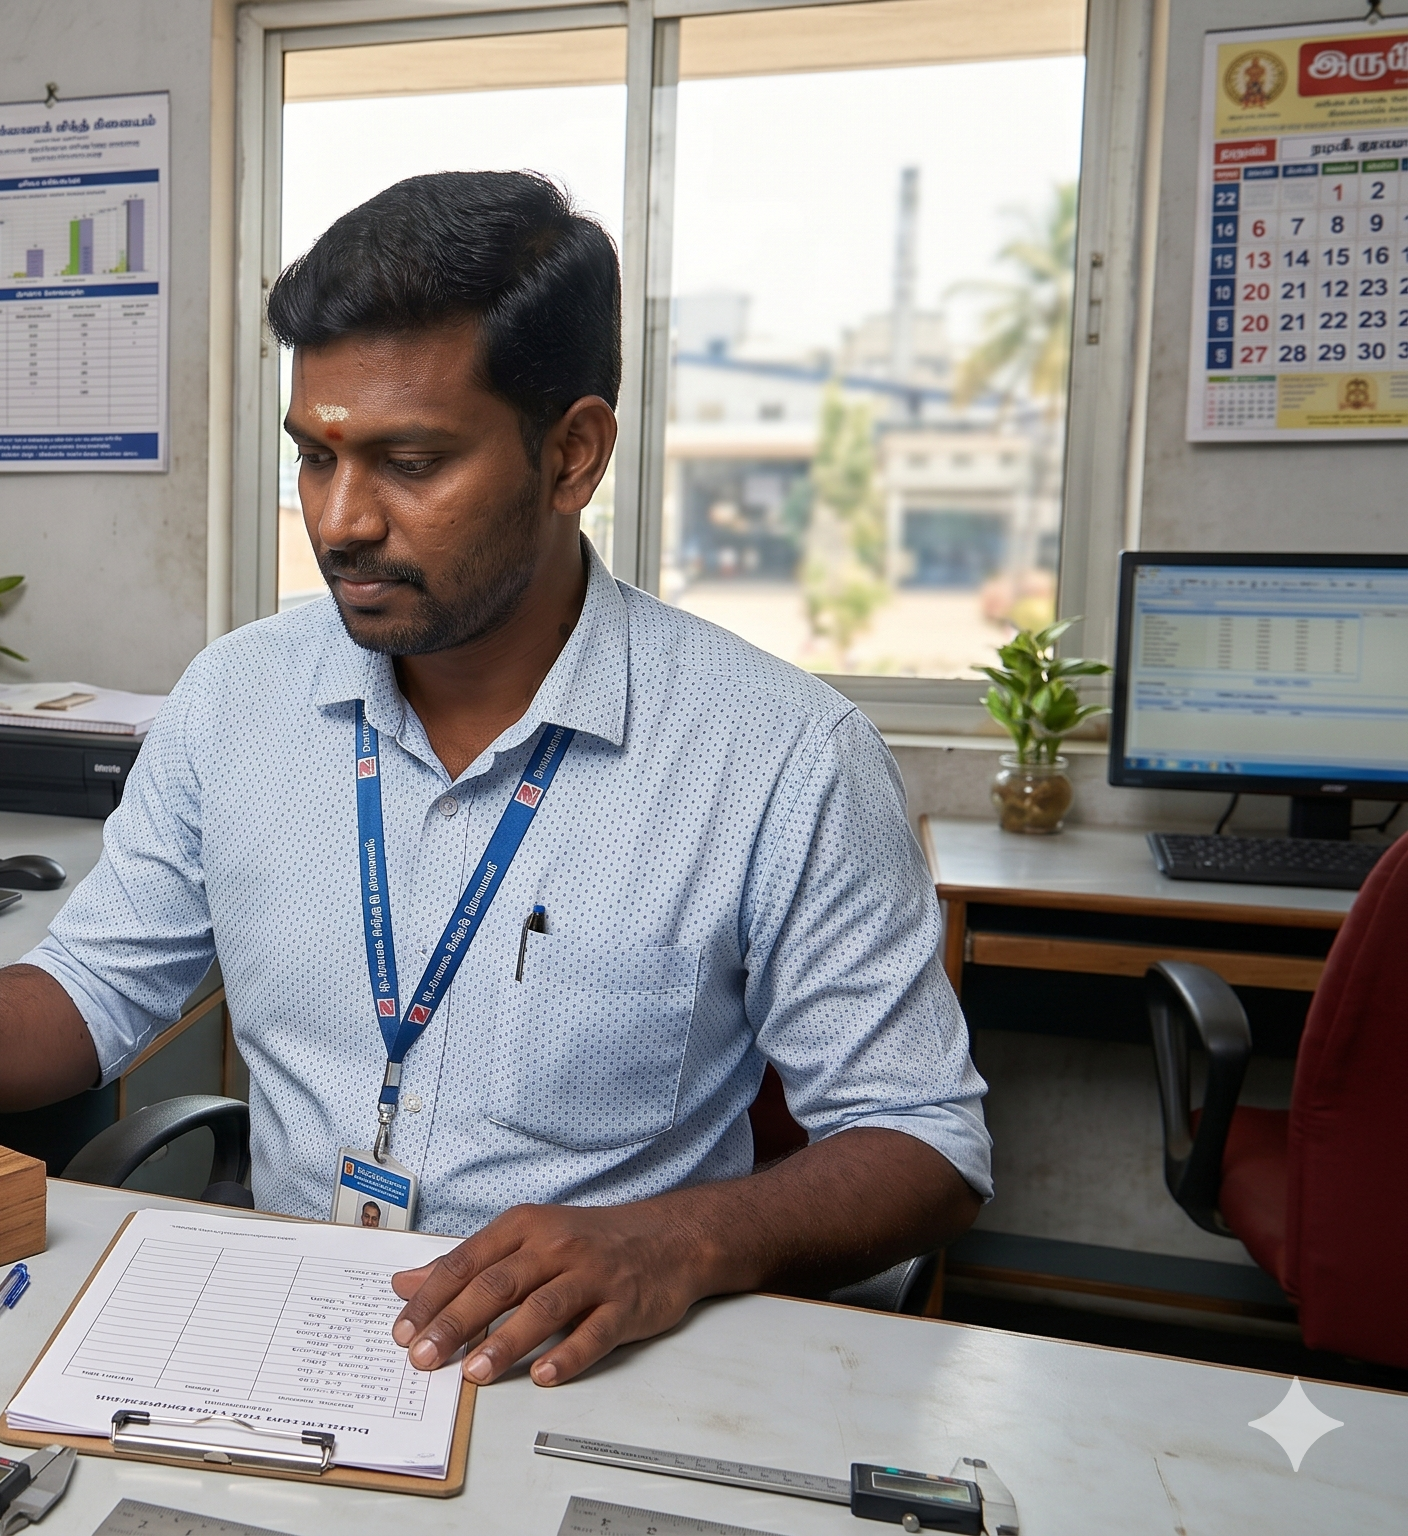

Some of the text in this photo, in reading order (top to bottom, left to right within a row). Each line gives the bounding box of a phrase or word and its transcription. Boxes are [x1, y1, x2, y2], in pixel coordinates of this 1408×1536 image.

[1332, 183, 1343, 202] 1
[1370, 181, 1386, 200] 2
[1251, 219, 1267, 238] 6
[1290, 217, 1305, 236] 7
[1331, 215, 1345, 234] 8
[1369, 214, 1384, 232] 9
[1245, 251, 1272, 270] 13
[1283, 250, 1310, 268] 14
[1322, 248, 1350, 266] 15
[1362, 247, 1390, 265] 16
[1242, 283, 1271, 301] 20
[1281, 281, 1307, 300] 21
[1321, 280, 1349, 298] 12
[1358, 278, 1389, 297] 23
[1241, 314, 1270, 332] 20
[1279, 313, 1306, 331] 21
[1319, 311, 1348, 330] 22
[1357, 310, 1388, 328] 23
[1239, 346, 1269, 364] 27
[1278, 344, 1307, 363] 28
[1317, 343, 1347, 361] 29
[1356, 342, 1387, 360] 30
